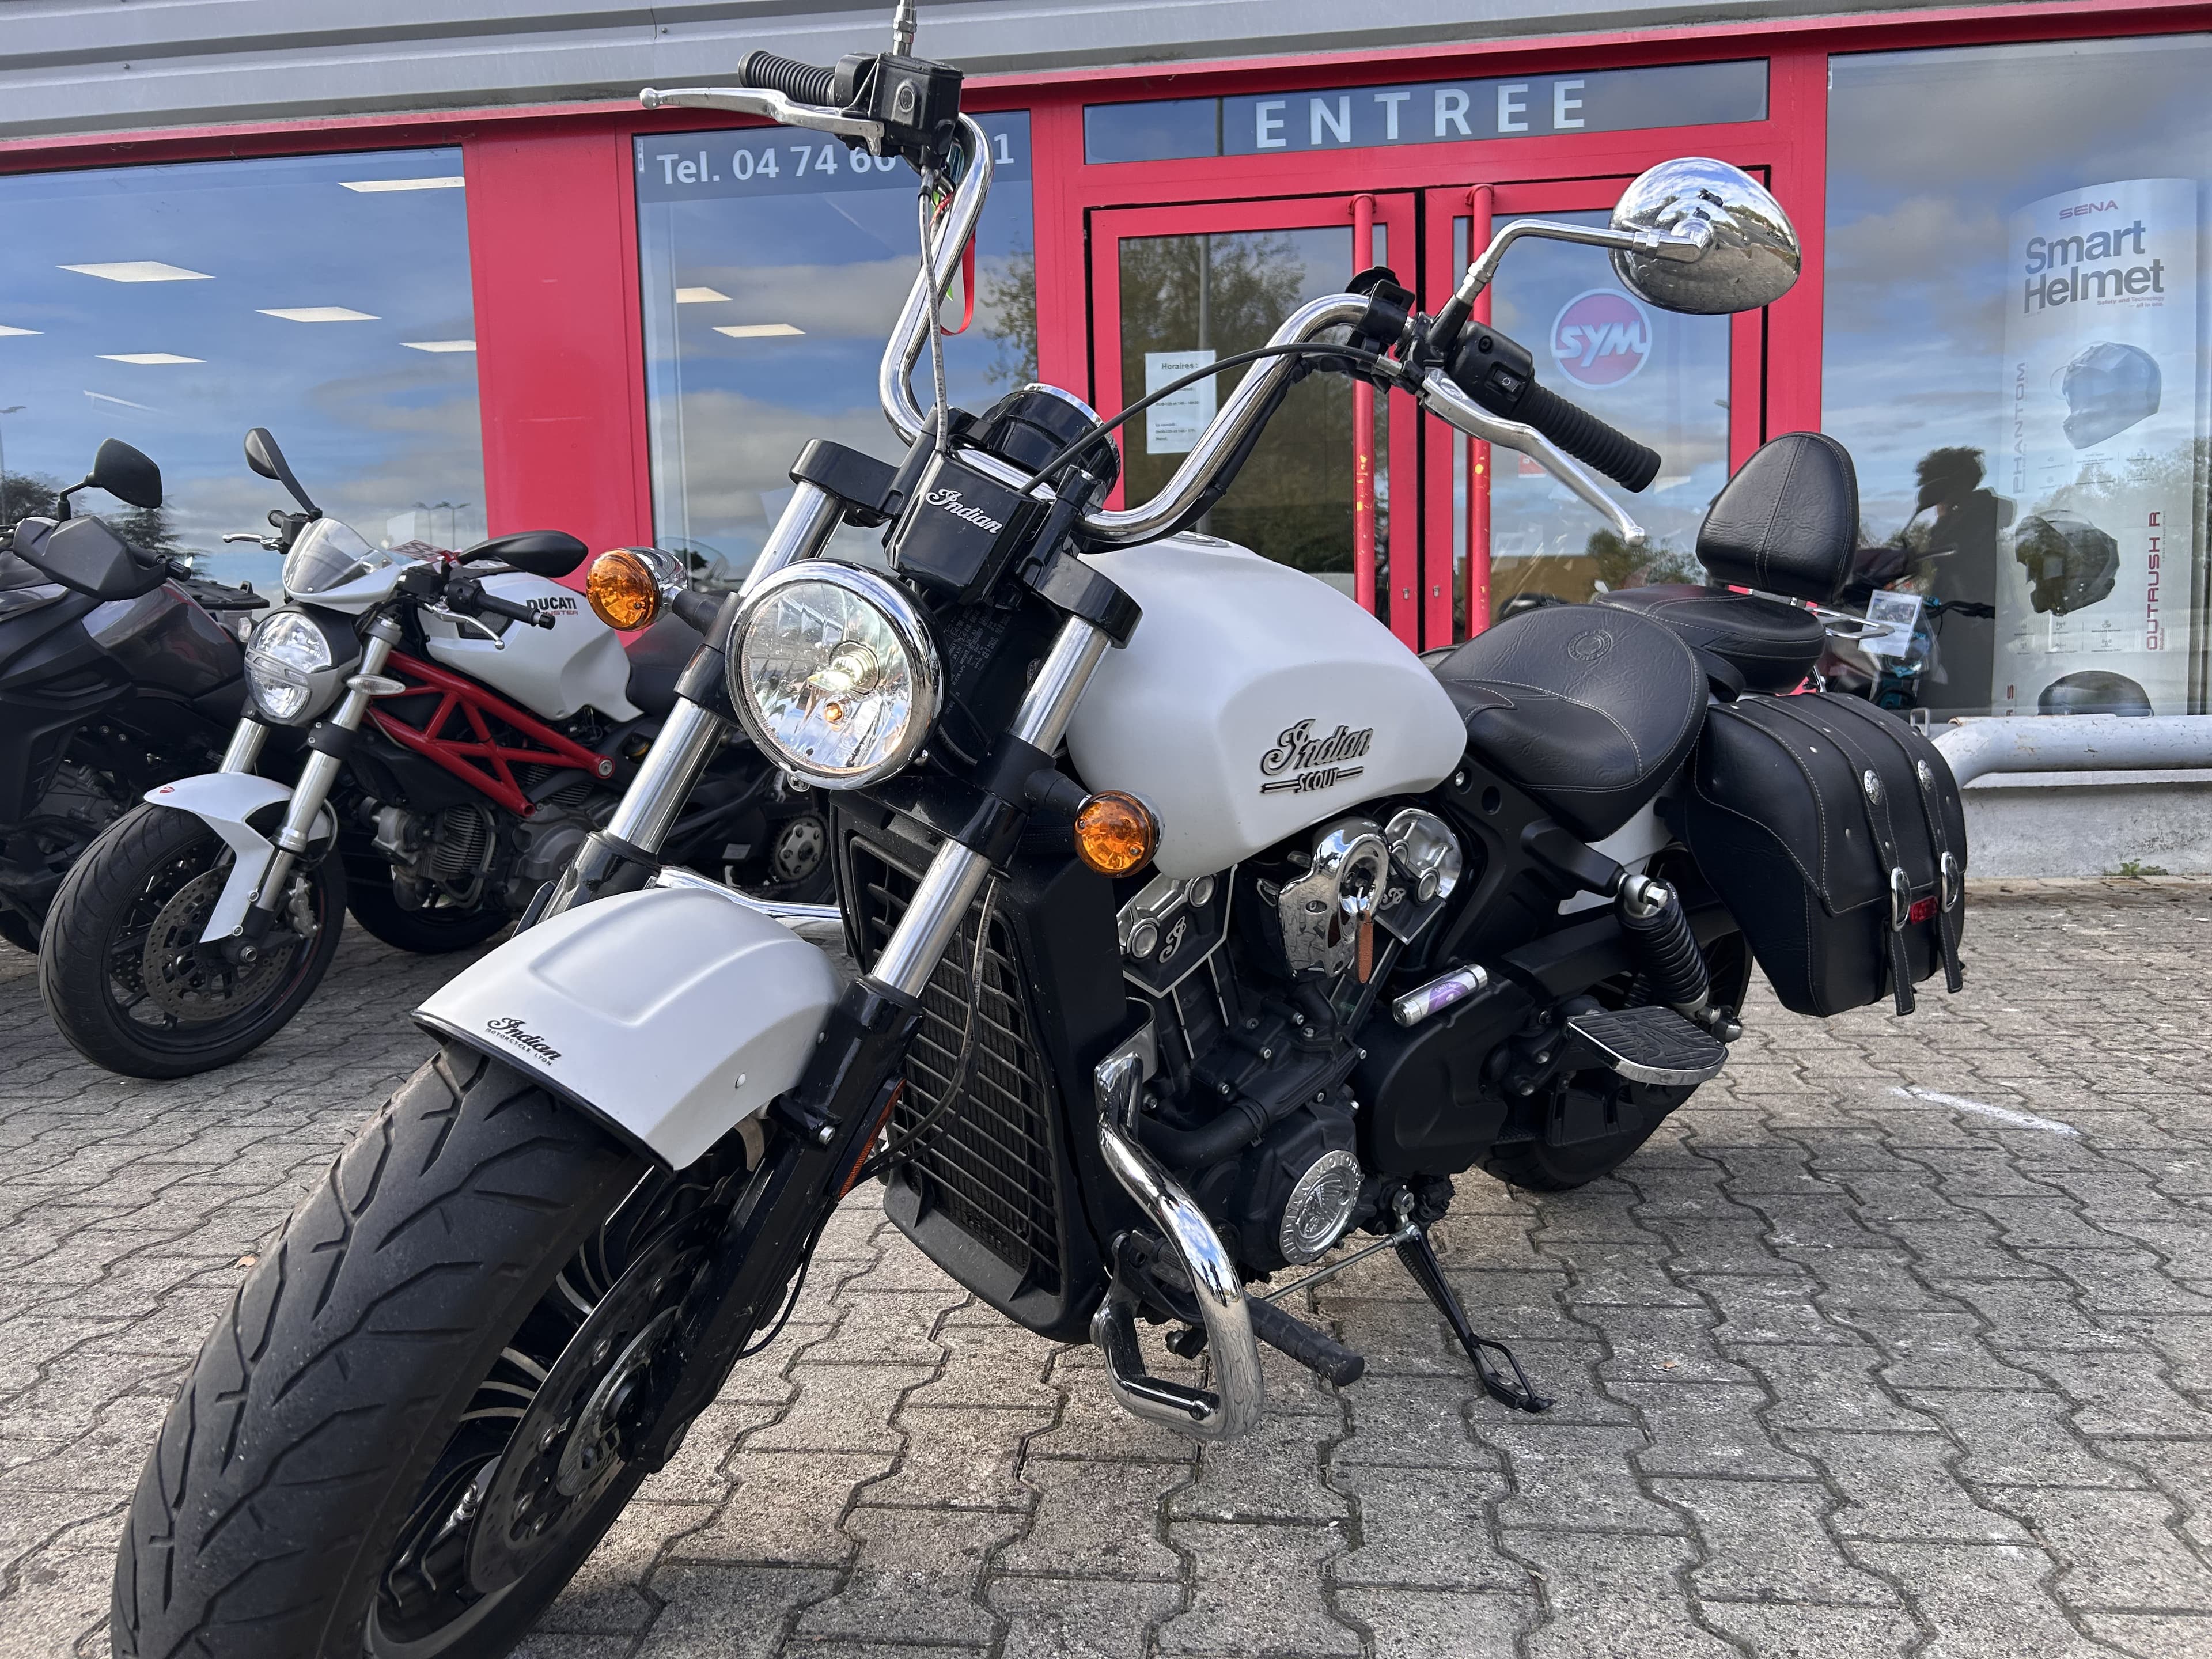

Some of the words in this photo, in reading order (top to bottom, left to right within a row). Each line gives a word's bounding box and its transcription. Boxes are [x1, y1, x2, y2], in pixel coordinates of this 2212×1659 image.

[1256, 80, 1585, 149] ENTREE
[656, 152, 720, 184] Tel.
[732, 147, 779, 179] 04
[790, 144, 838, 176] 74
[2059, 200, 2118, 220] SENA
[2025, 220, 2146, 275] Smart
[2024, 259, 2165, 314] Helmet
[930, 298, 940, 348] GOODRIDGE
[1555, 320, 1647, 367] SYM
[2013, 362, 2025, 494] PHANTOM
[926, 488, 1003, 533] Indian
[2149, 511, 2160, 527] R
[526, 597, 577, 610] DUCATI
[2146, 537, 2160, 650] OUTRUSH
[1260, 719, 1373, 775] Indian
[1294, 767, 1339, 793] SCOUT
[485, 1028, 531, 1052] MOTORCYCLE
[535, 1053, 552, 1066] LYON
[487, 1017, 562, 1060] Indian
